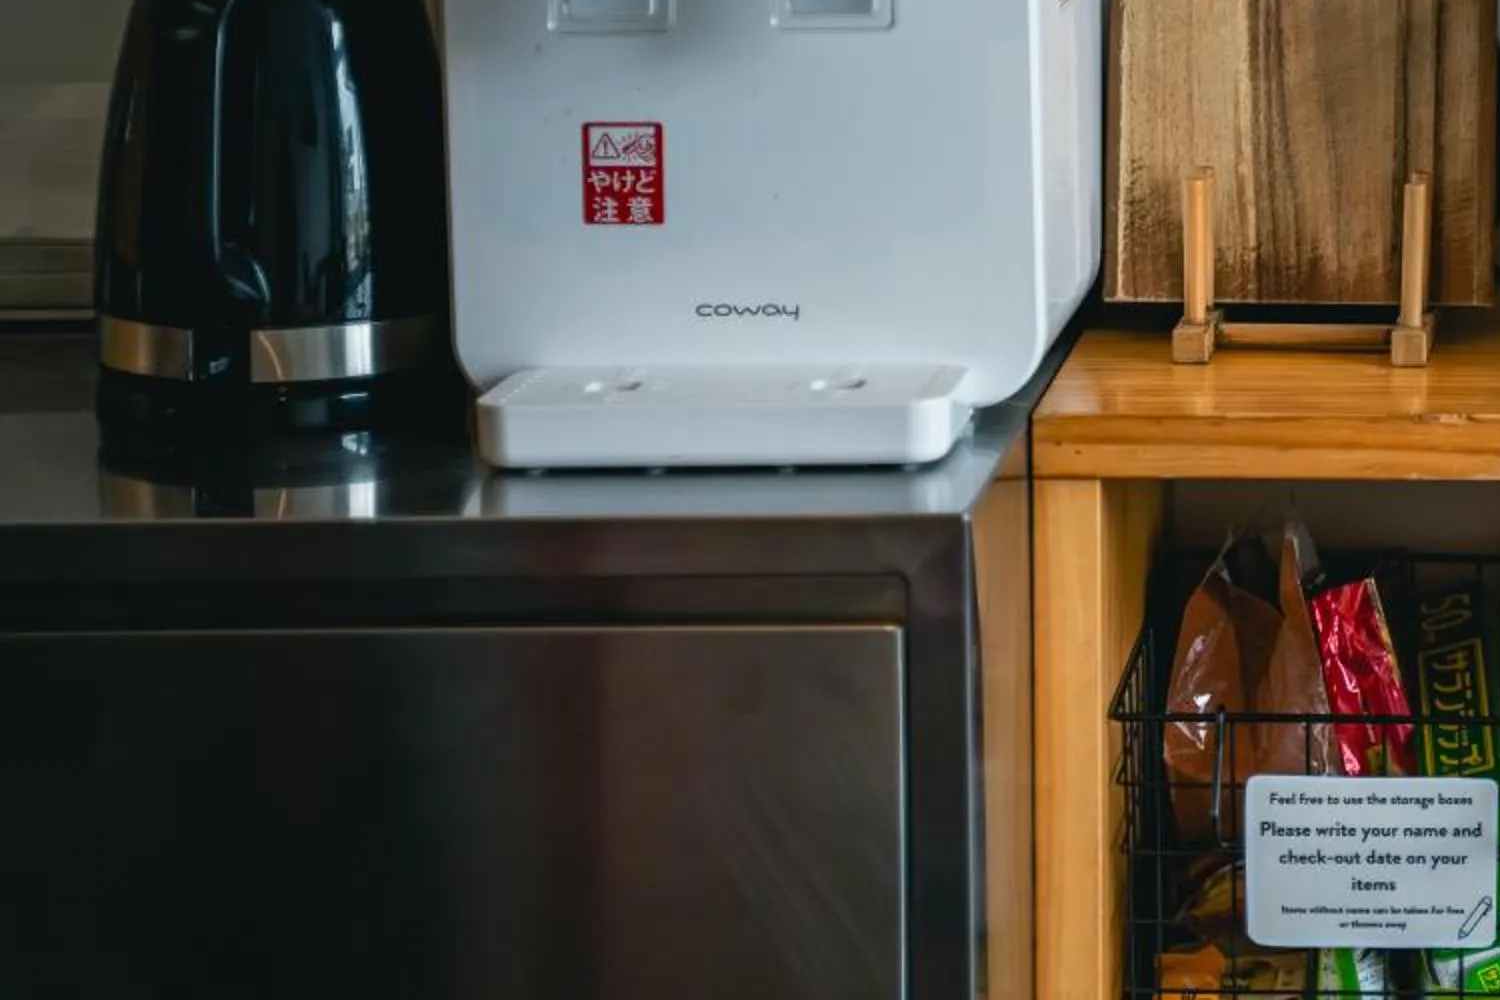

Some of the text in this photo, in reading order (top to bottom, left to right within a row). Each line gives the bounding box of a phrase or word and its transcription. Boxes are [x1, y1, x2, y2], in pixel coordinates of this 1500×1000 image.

[587, 169, 657, 194] やけど
[591, 196, 655, 223] 注意
[695, 303, 801, 321] coway
[1269, 792, 1473, 809] Feel free to use the storage boxes
[1260, 820, 1483, 842] Please write your name and
[1279, 848, 1468, 870] check-out date on your
[1351, 877, 1397, 891] items
[1309, 904, 1343, 914] without
[1373, 907, 1389, 915] can
[1385, 921, 1407, 931] away
